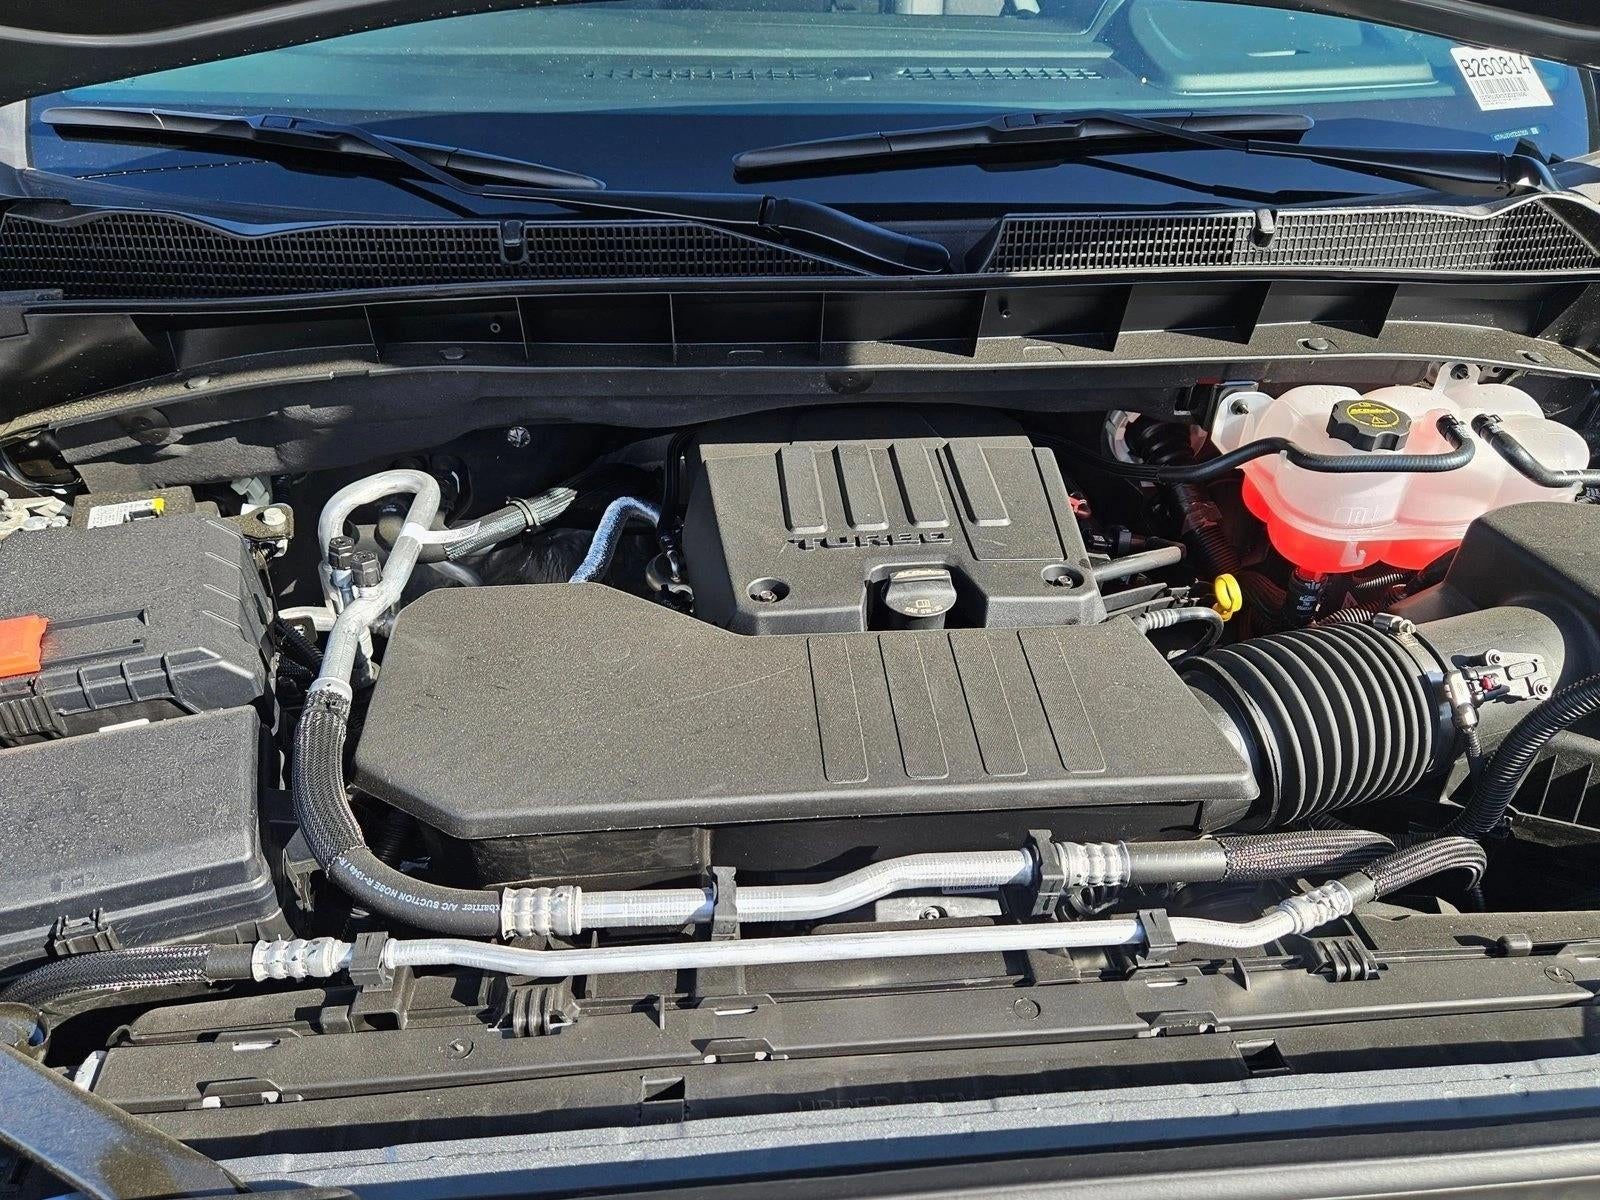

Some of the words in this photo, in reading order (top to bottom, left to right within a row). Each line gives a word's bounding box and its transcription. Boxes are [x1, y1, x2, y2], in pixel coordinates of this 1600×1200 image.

[1460, 55, 1531, 78] B260814
[787, 531, 953, 551] TURBO
[373, 881, 399, 898] HOSE
[398, 892, 440, 910] SUCTION
[441, 902, 459, 912] A/C
